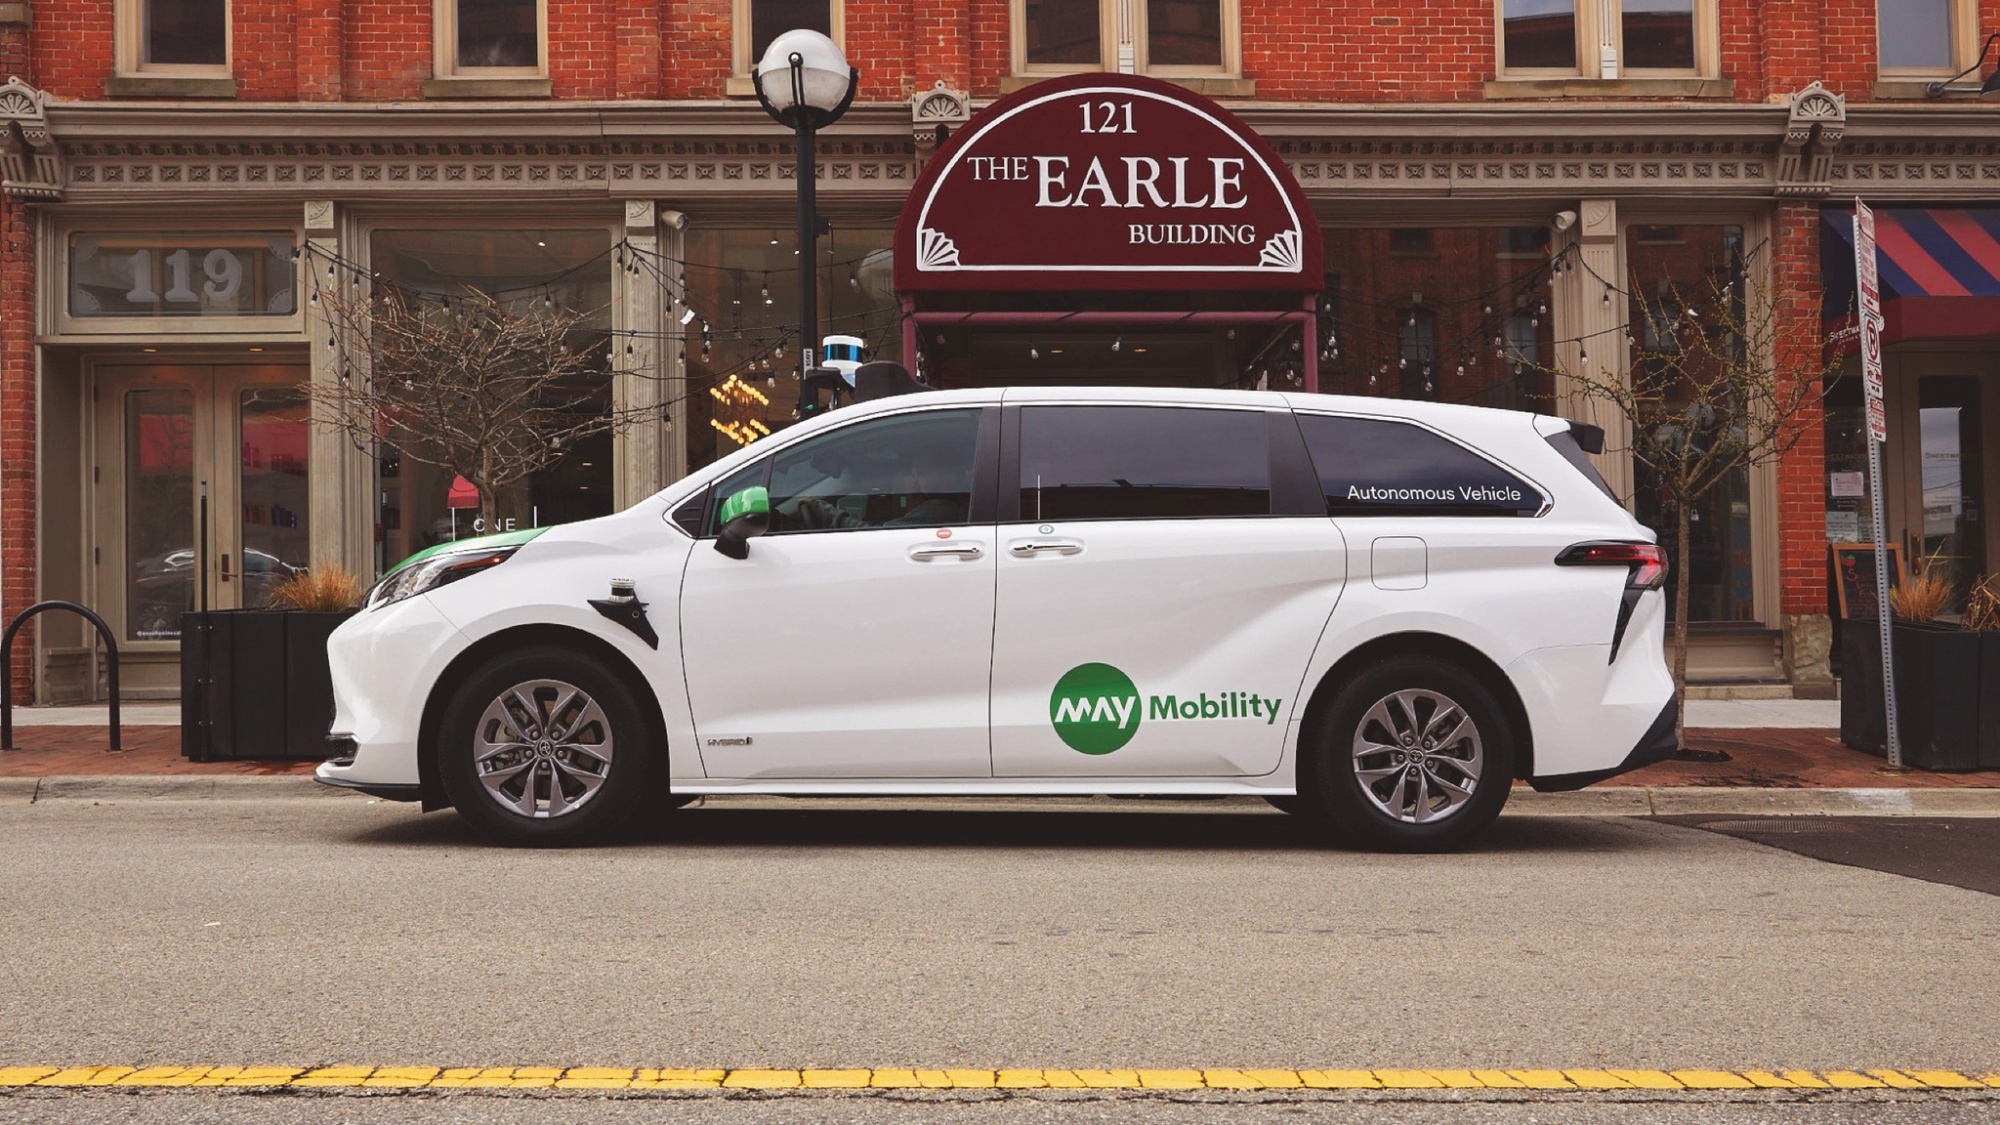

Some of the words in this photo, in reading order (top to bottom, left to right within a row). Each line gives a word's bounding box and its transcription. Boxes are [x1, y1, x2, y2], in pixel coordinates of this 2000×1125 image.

[1079, 101, 1138, 134] 121
[967, 156, 1030, 181] THE
[1032, 155, 1249, 209] EARLE
[1128, 224, 1256, 245] BUILDING
[126, 249, 243, 302] 119
[1347, 485, 1455, 501] Autonomous
[1458, 485, 1522, 501] Vehicle
[1149, 692, 1282, 725] Mobility
